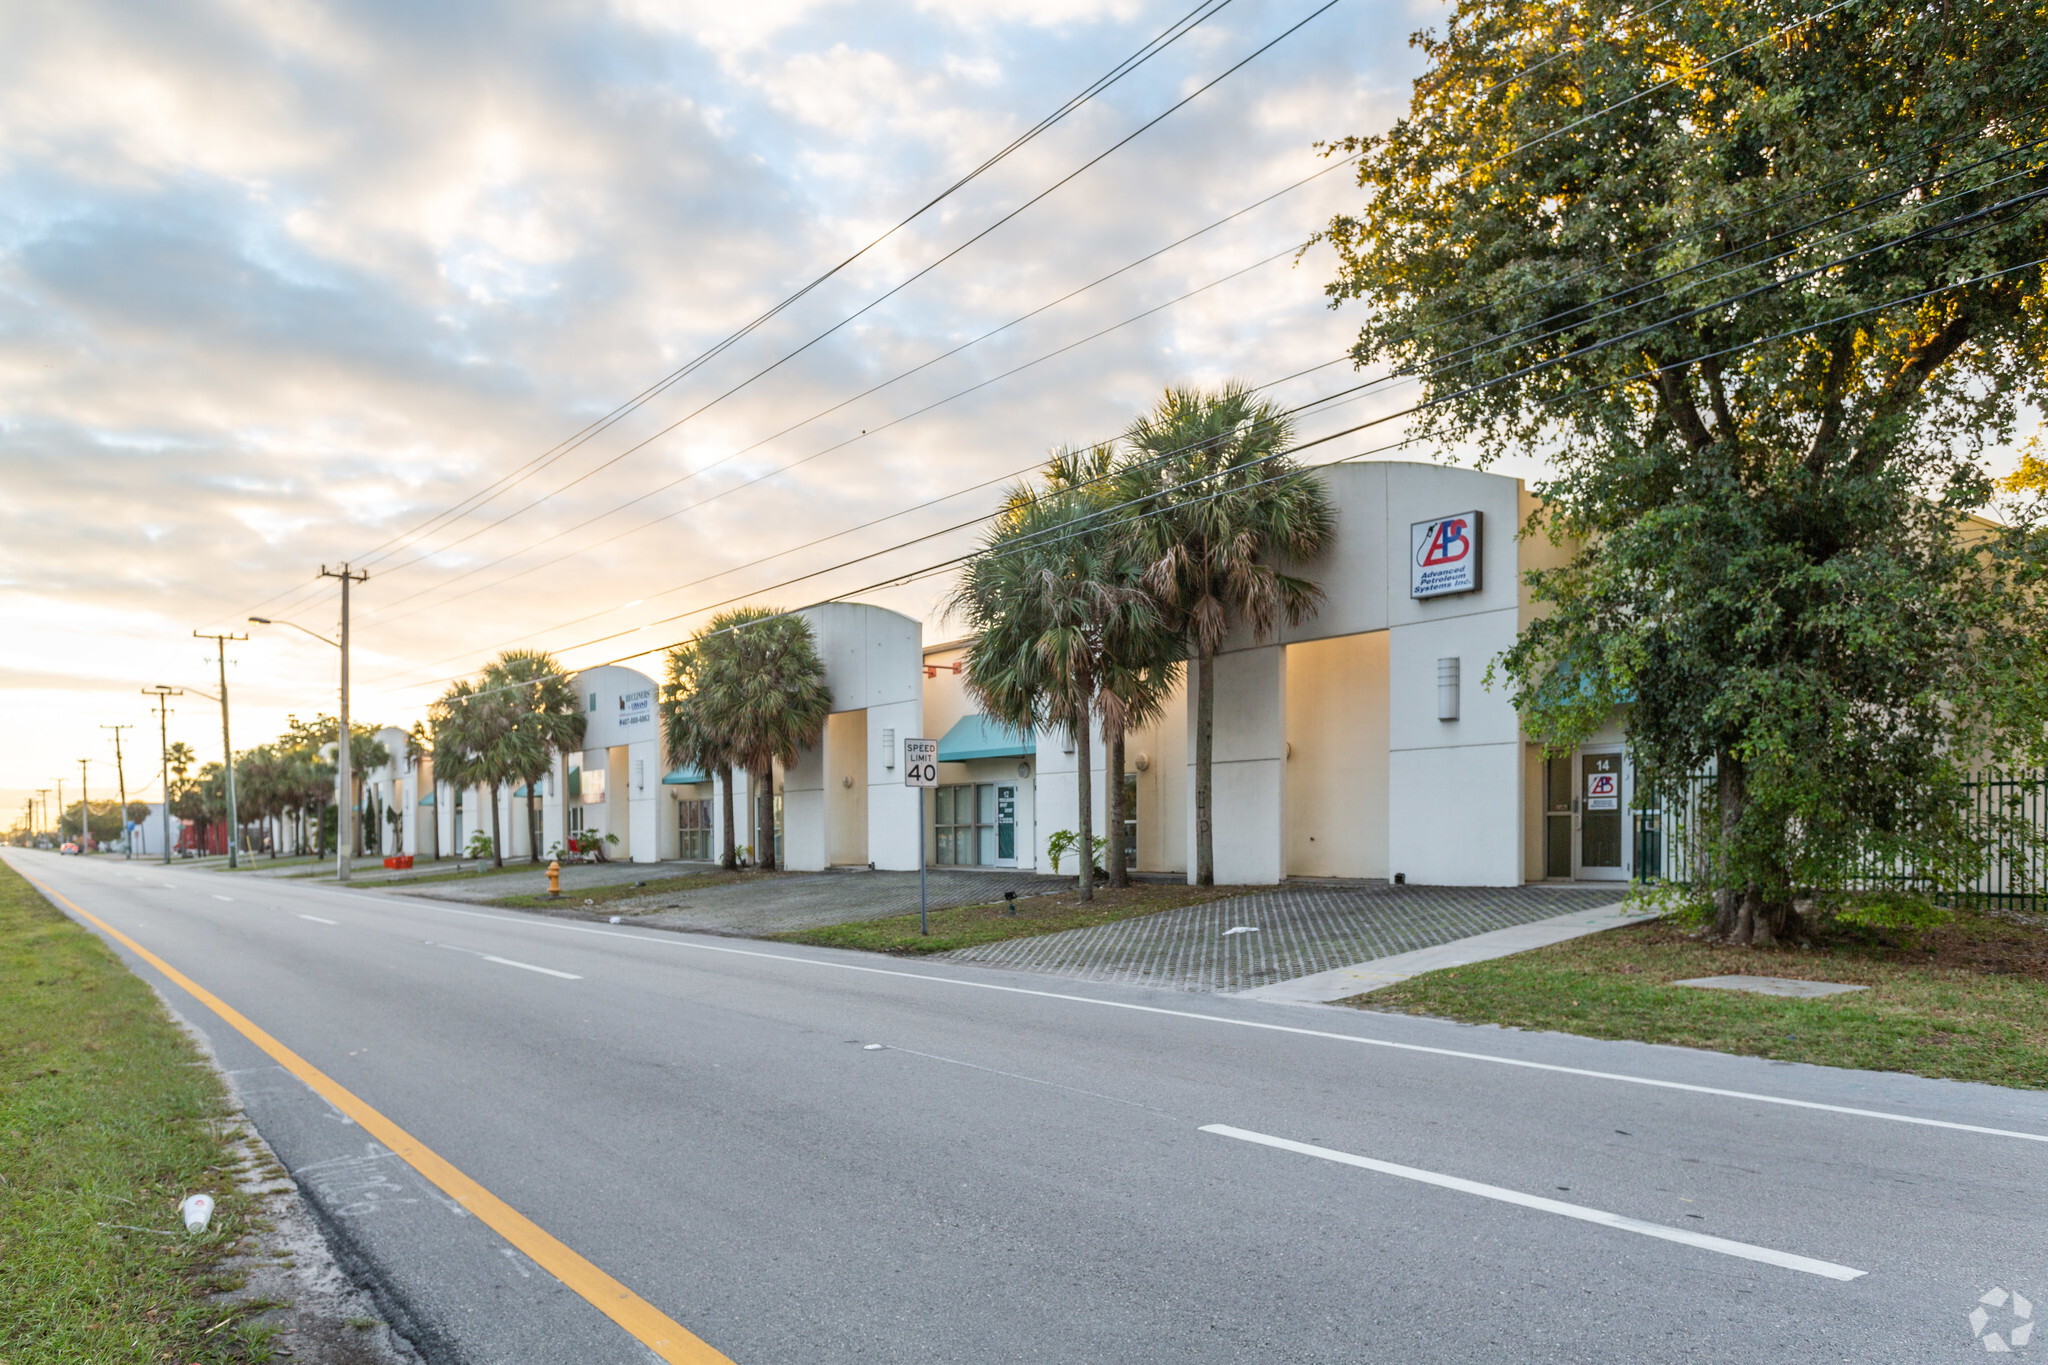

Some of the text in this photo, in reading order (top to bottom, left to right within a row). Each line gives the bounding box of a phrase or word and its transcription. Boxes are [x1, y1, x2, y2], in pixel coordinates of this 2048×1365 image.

[1421, 565, 1466, 580] Advanced
[1414, 578, 1472, 594] Systems Inc.
[1420, 573, 1466, 586] Petroleum
[907, 744, 935, 753] SPEED
[910, 754, 932, 762] LIMIT
[1596, 759, 1610, 771] 14
[907, 764, 936, 782] 40
